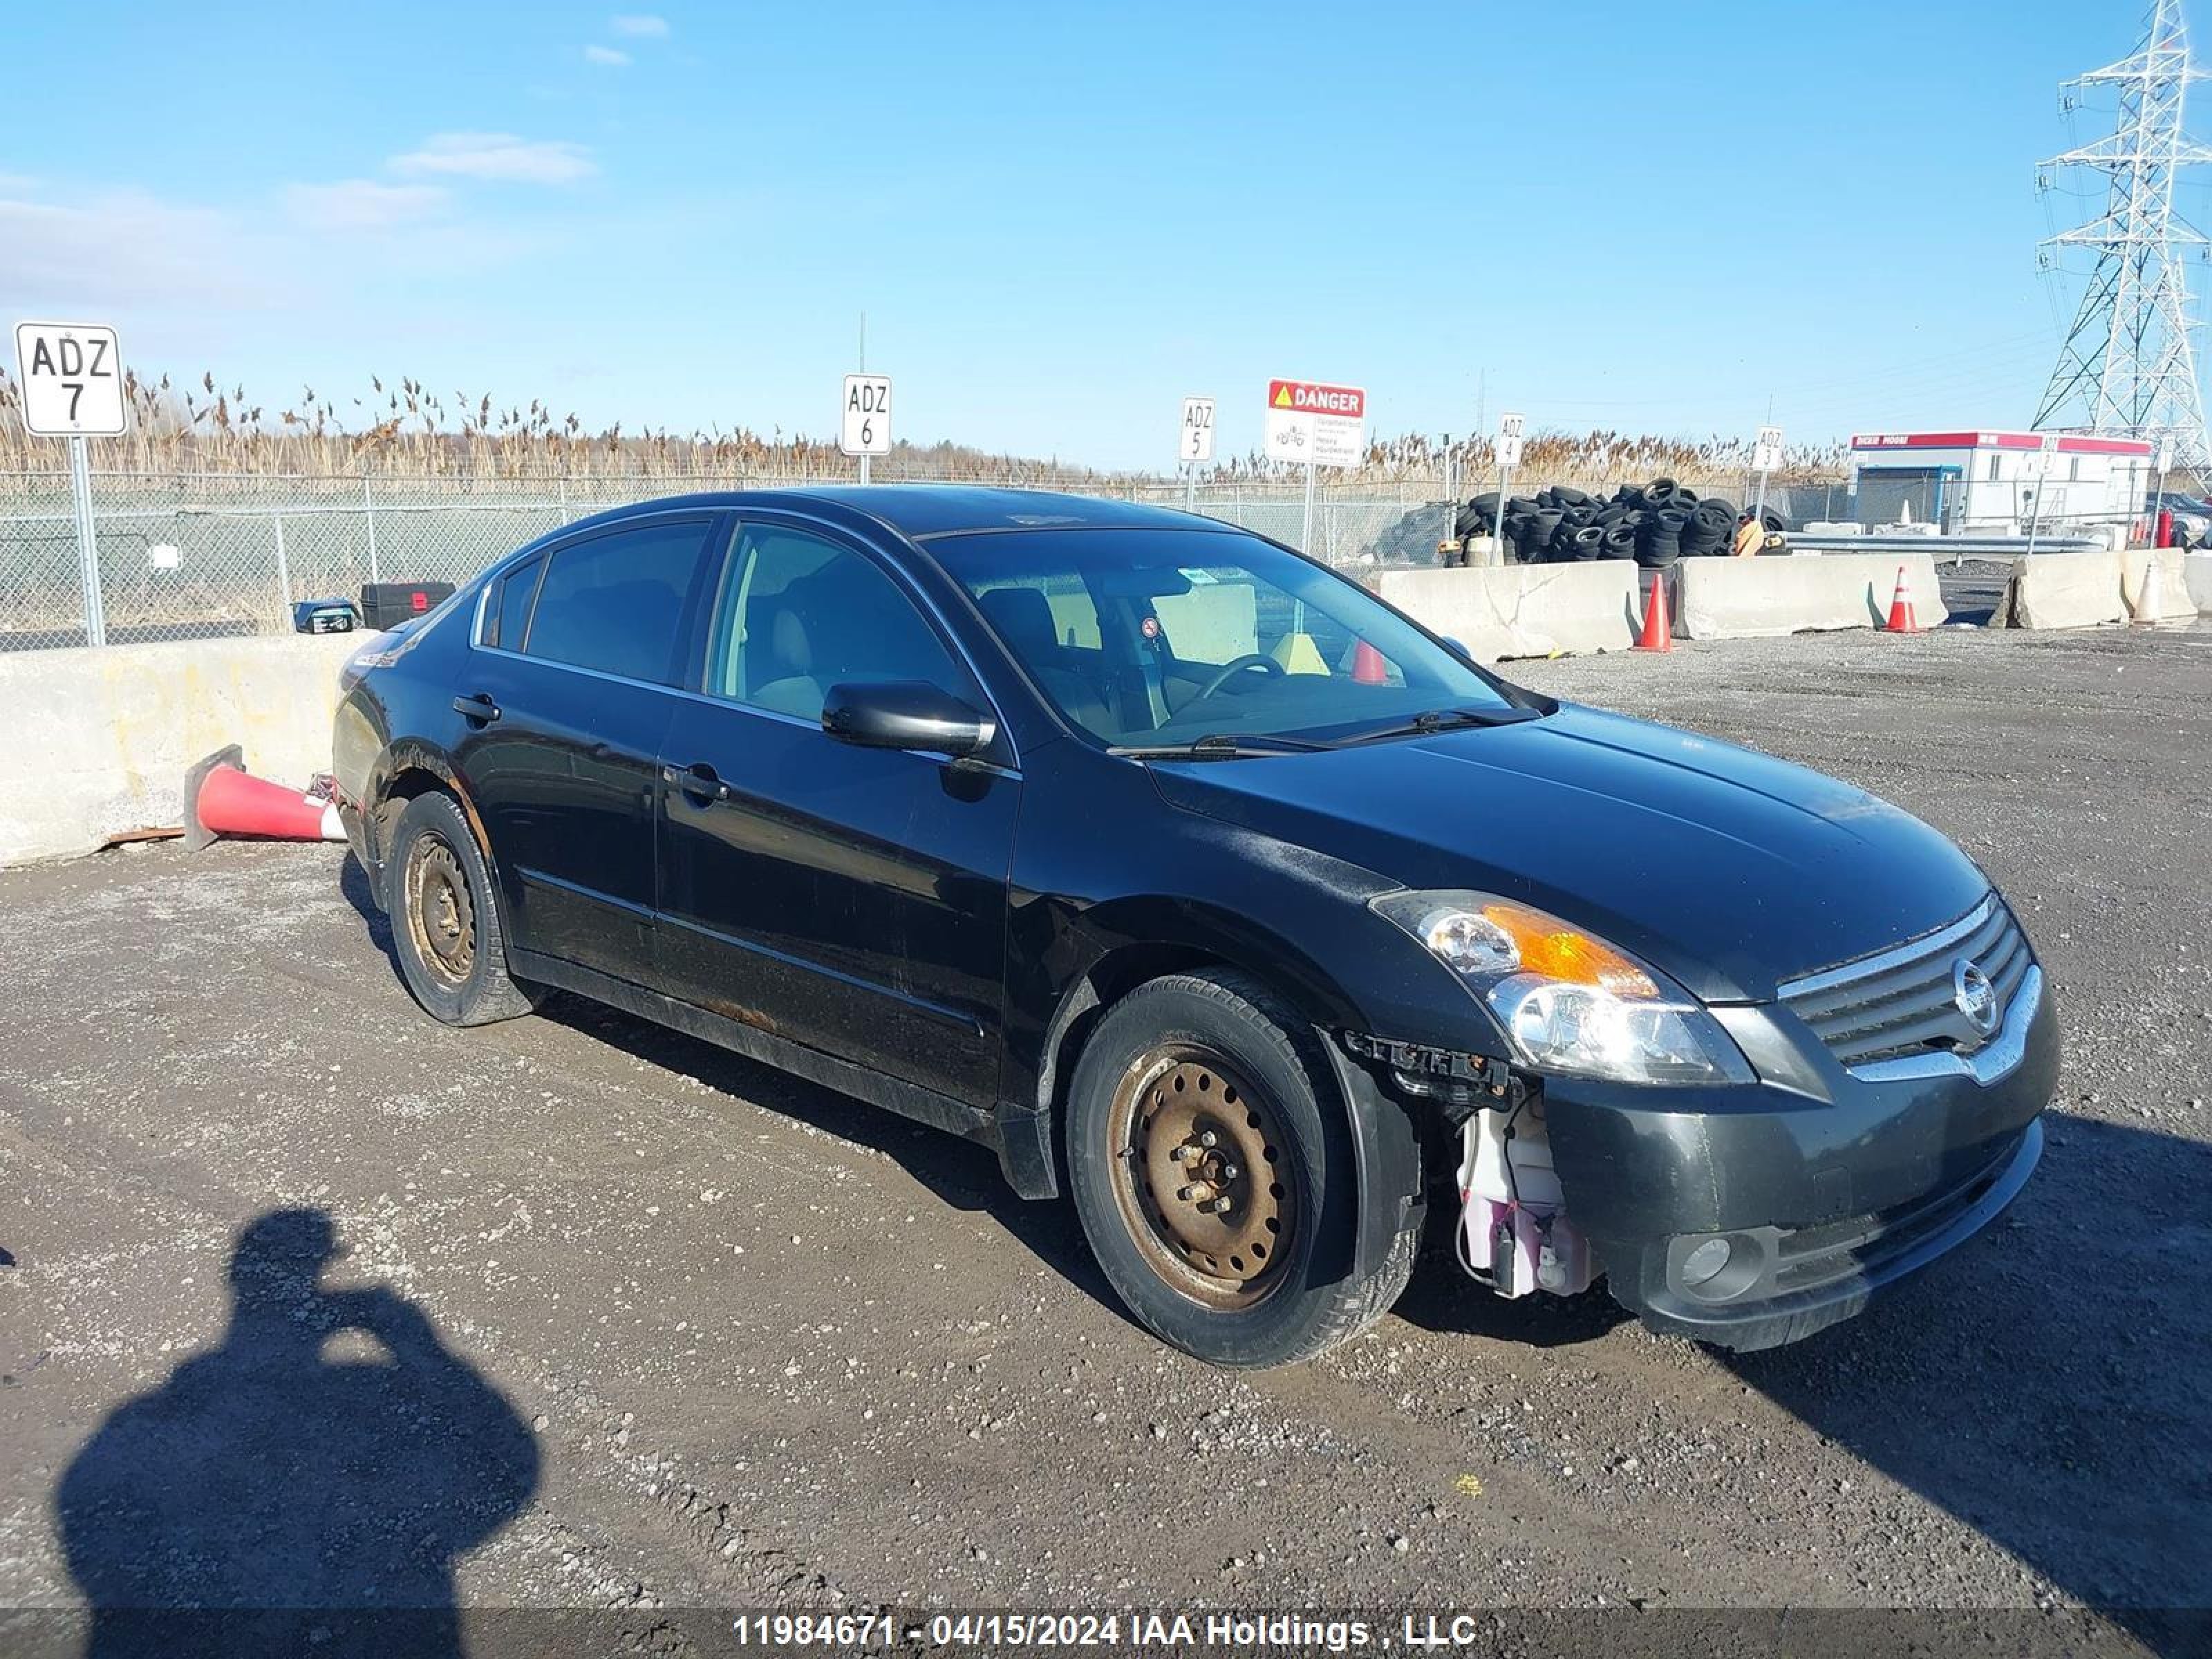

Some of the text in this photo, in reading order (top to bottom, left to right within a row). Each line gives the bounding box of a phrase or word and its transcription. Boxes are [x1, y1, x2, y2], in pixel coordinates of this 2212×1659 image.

[32, 337, 111, 377] ADZ
[61, 383, 84, 421] 7
[847, 384, 887, 413] ADZ
[1295, 388, 1359, 413] DANGER
[1185, 405, 1212, 429] ADZ
[1501, 419, 1523, 438] ADZ
[861, 418, 872, 444] 6
[1192, 431, 1201, 455] 5
[1759, 431, 1781, 449] ADZ
